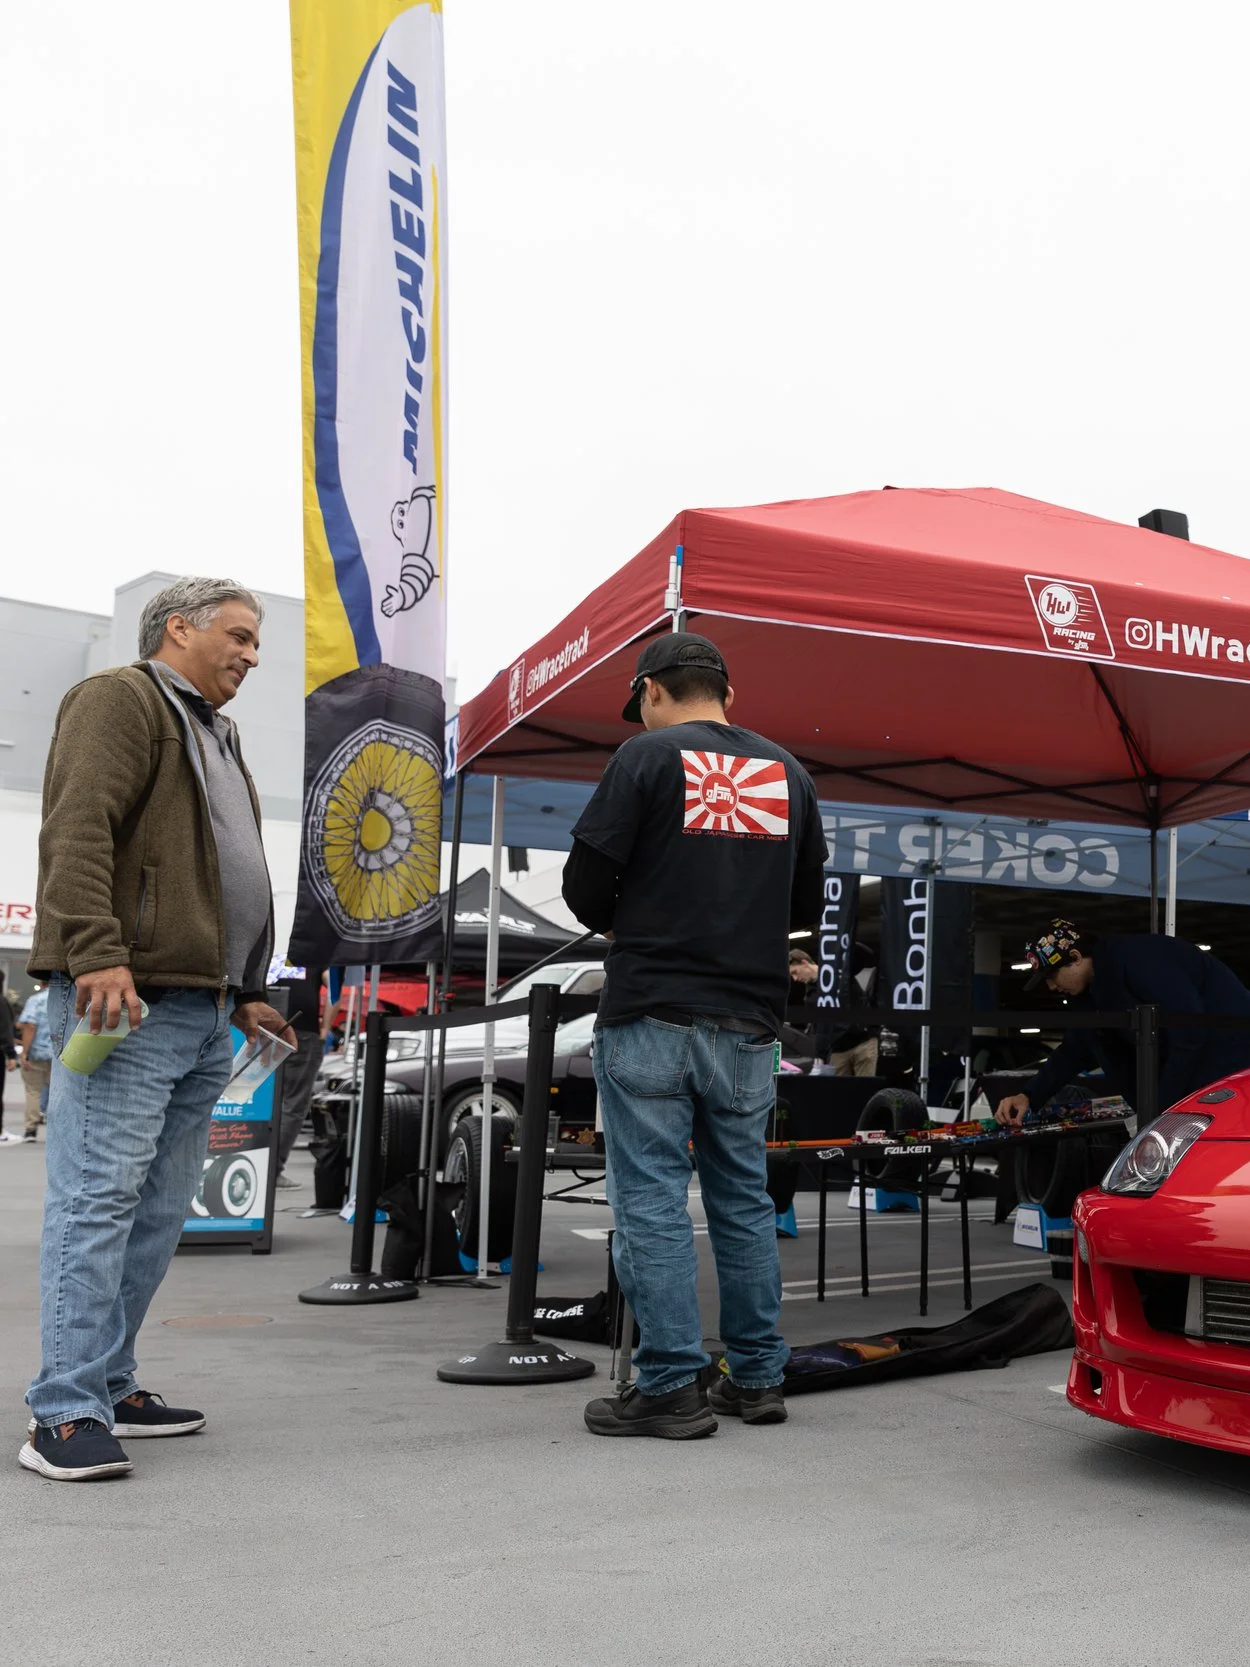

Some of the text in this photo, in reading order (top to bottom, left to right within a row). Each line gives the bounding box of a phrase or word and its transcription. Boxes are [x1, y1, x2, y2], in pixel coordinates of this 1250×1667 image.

[387, 58, 427, 476] MICHELIN
[1053, 627, 1096, 641] RACING
[705, 831, 745, 839] JAPANESE
[884, 1145, 932, 1155] FALKEN
[509, 1356, 548, 1365] NOT
[556, 1354, 566, 1362] A
